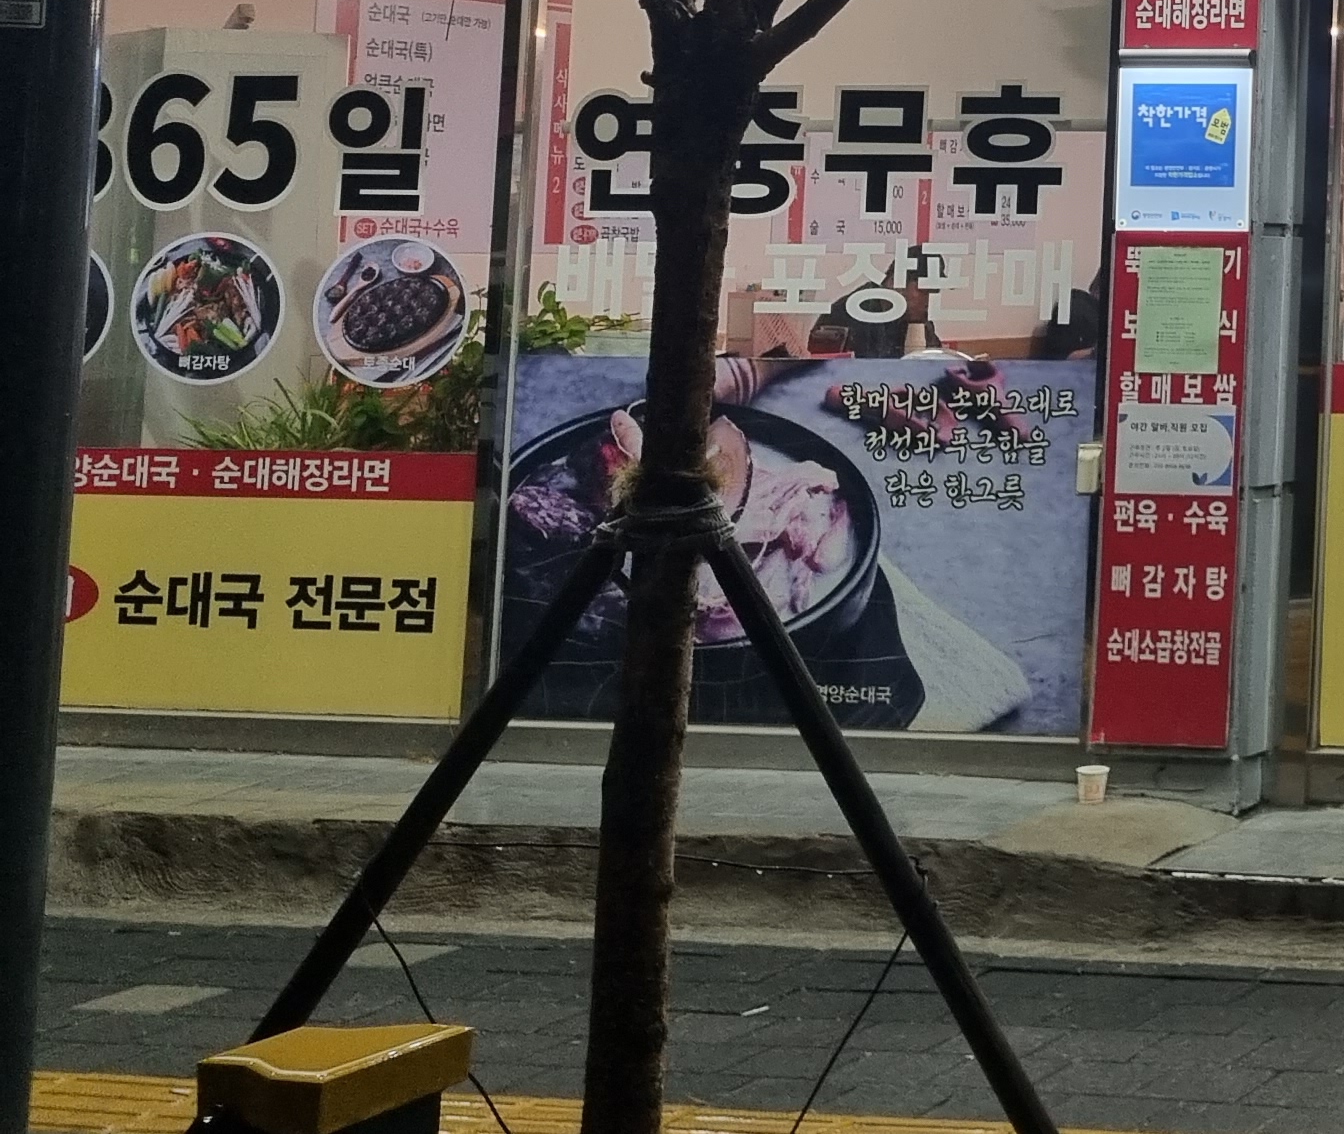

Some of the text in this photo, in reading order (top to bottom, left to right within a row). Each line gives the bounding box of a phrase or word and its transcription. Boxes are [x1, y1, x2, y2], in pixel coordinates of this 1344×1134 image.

[1138, 104, 1208, 128] 착한가격
[840, 383, 940, 420] 할머니의
[864, 427, 1051, 465] 정성과 푸근함을
[212, 456, 391, 493] 순대해장라면
[885, 473, 1025, 510] 담은 한그릇
[1114, 499, 1229, 535] 편육 수육
[114, 569, 437, 633] 순대국 전문점
[1106, 627, 1222, 666] 순대소곱창전골
